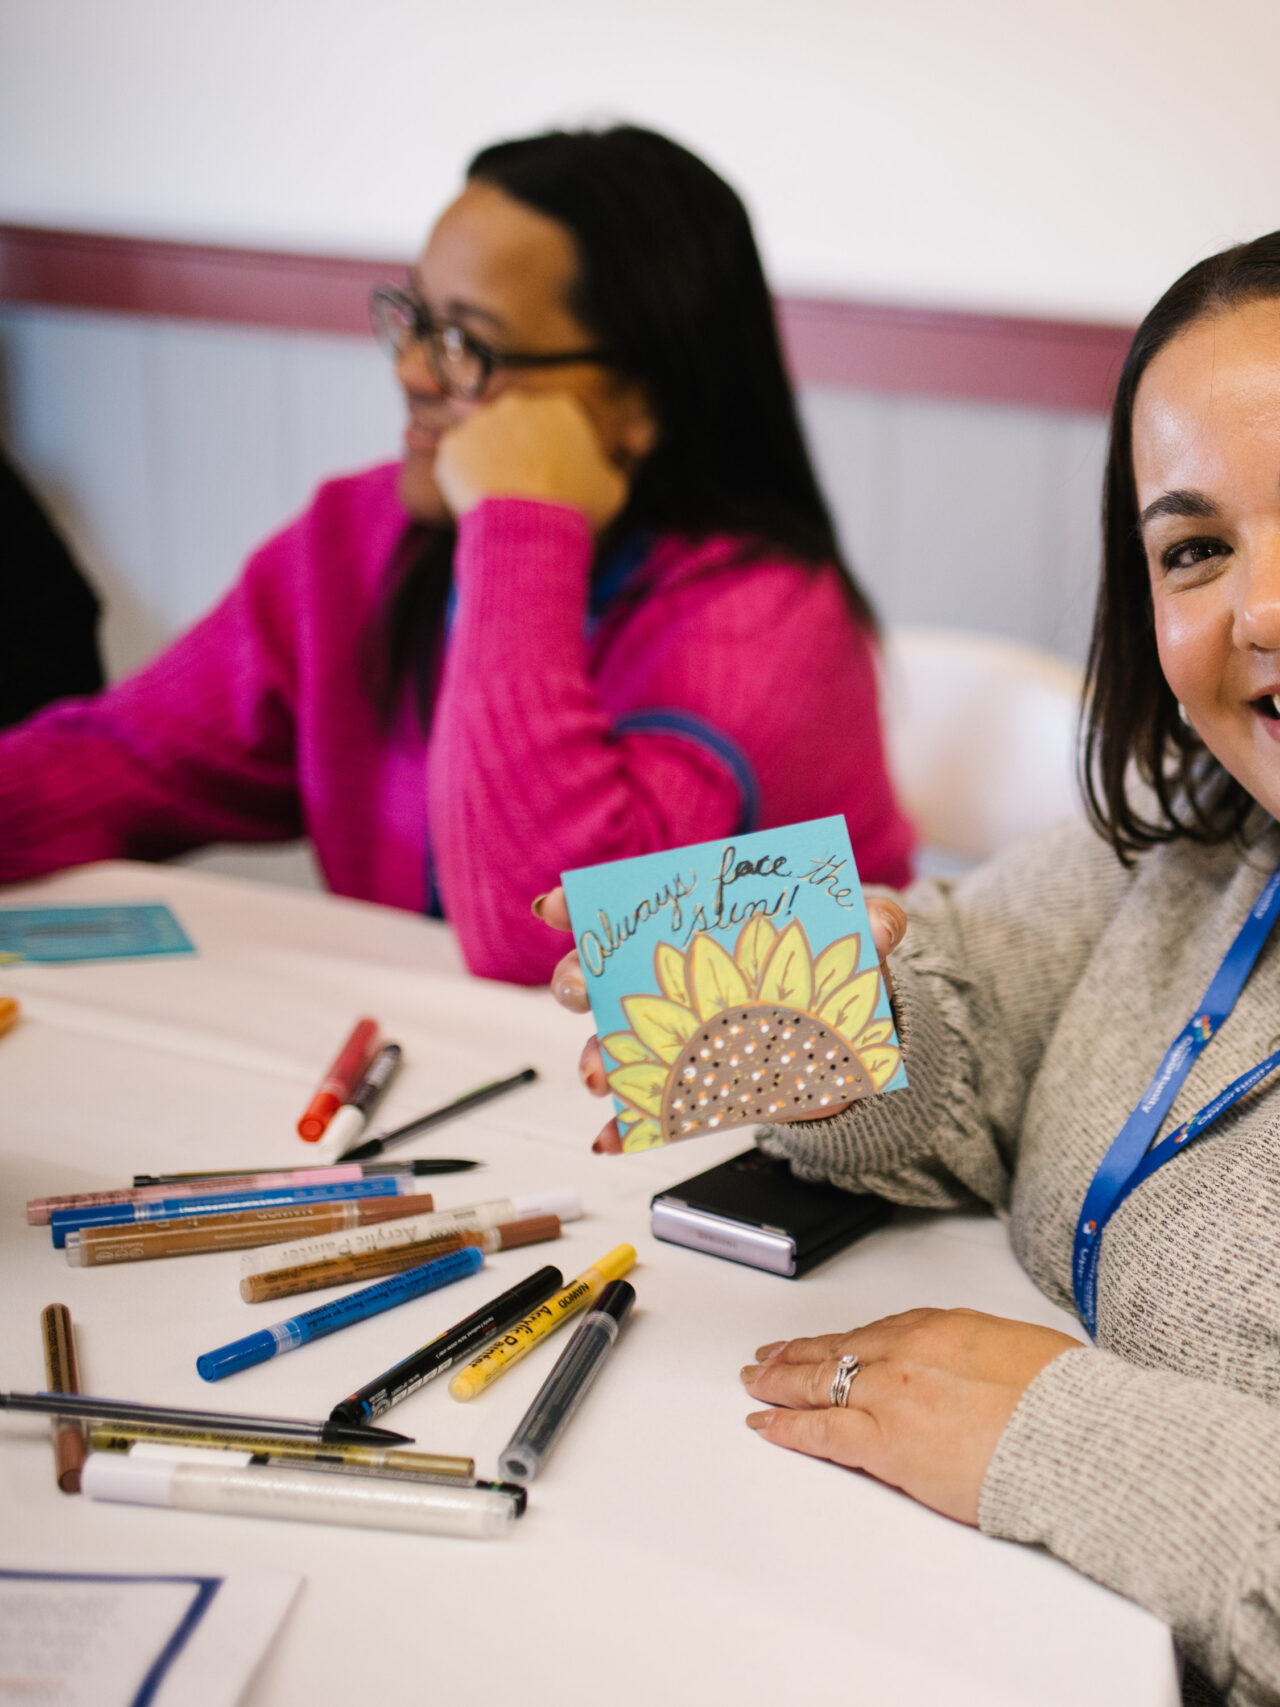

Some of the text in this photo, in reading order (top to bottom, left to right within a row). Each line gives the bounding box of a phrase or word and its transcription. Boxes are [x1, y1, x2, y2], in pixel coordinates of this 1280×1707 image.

[708, 845, 793, 916] face
[797, 851, 855, 910] the
[558, 1282, 590, 1309] NAWOD
[509, 1305, 553, 1336] Acrylic
[469, 1335, 518, 1368] Painter
